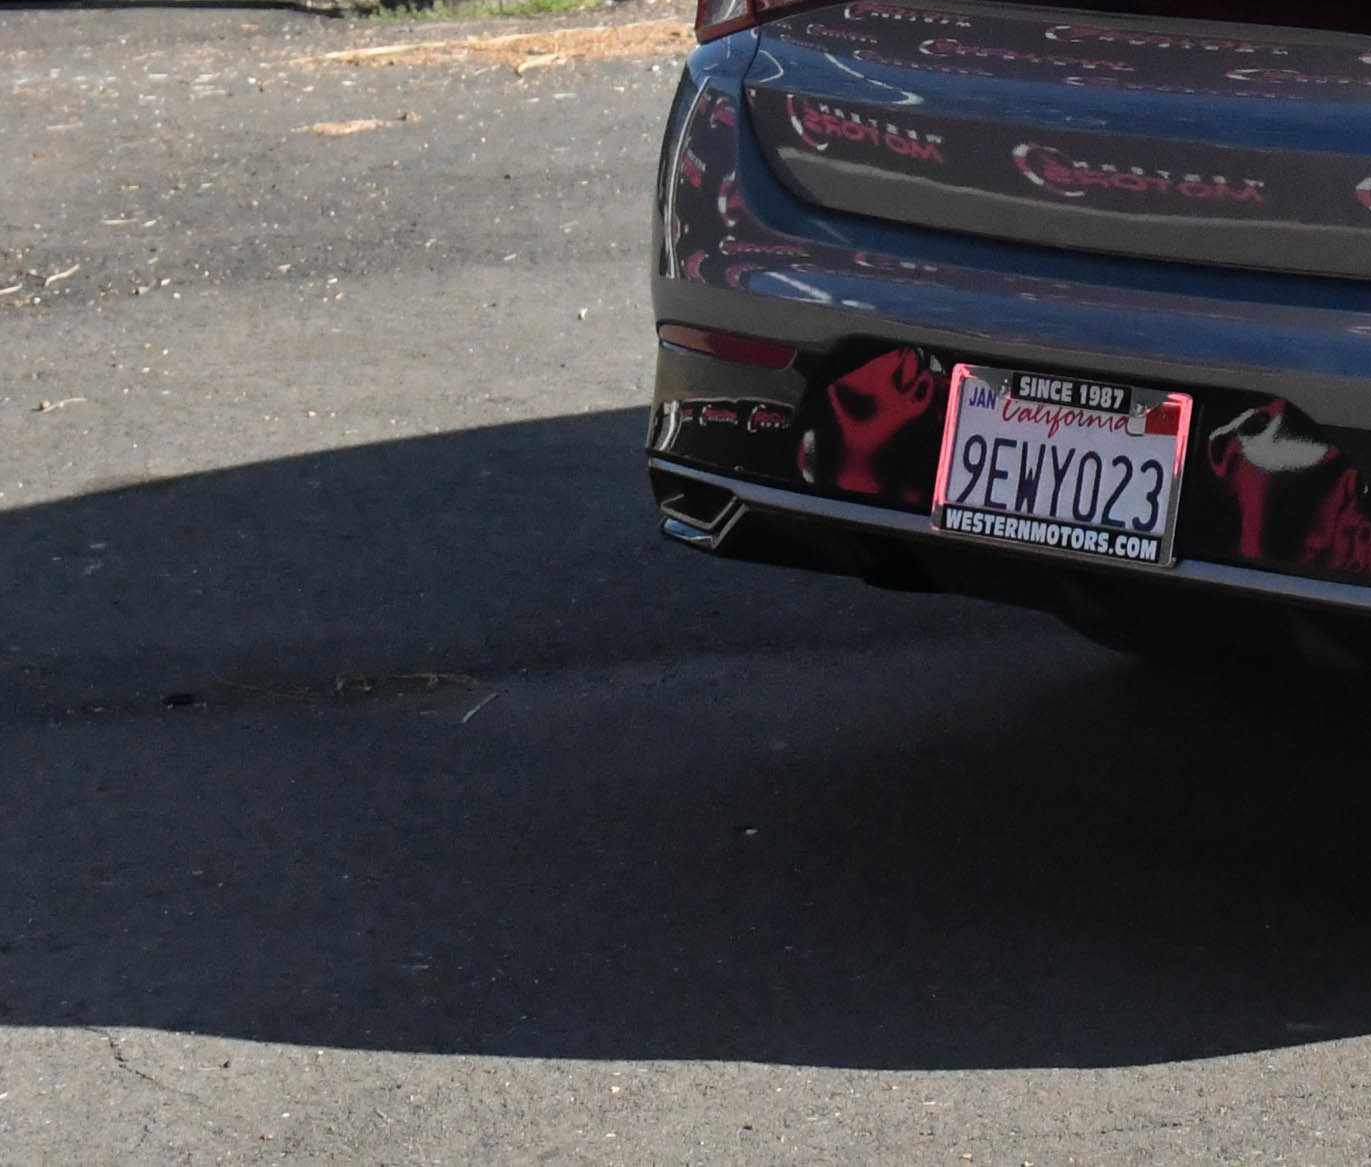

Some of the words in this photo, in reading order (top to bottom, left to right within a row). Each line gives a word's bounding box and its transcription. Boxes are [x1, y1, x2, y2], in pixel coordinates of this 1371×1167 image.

[969, 387, 997, 410] JAN
[1019, 376, 1073, 403] SINCE
[1079, 385, 1125, 409] 1987
[1002, 397, 1144, 439] California
[955, 434, 1164, 532] 9EWY023
[945, 508, 1158, 561] WESTERNMOTORS.COM
